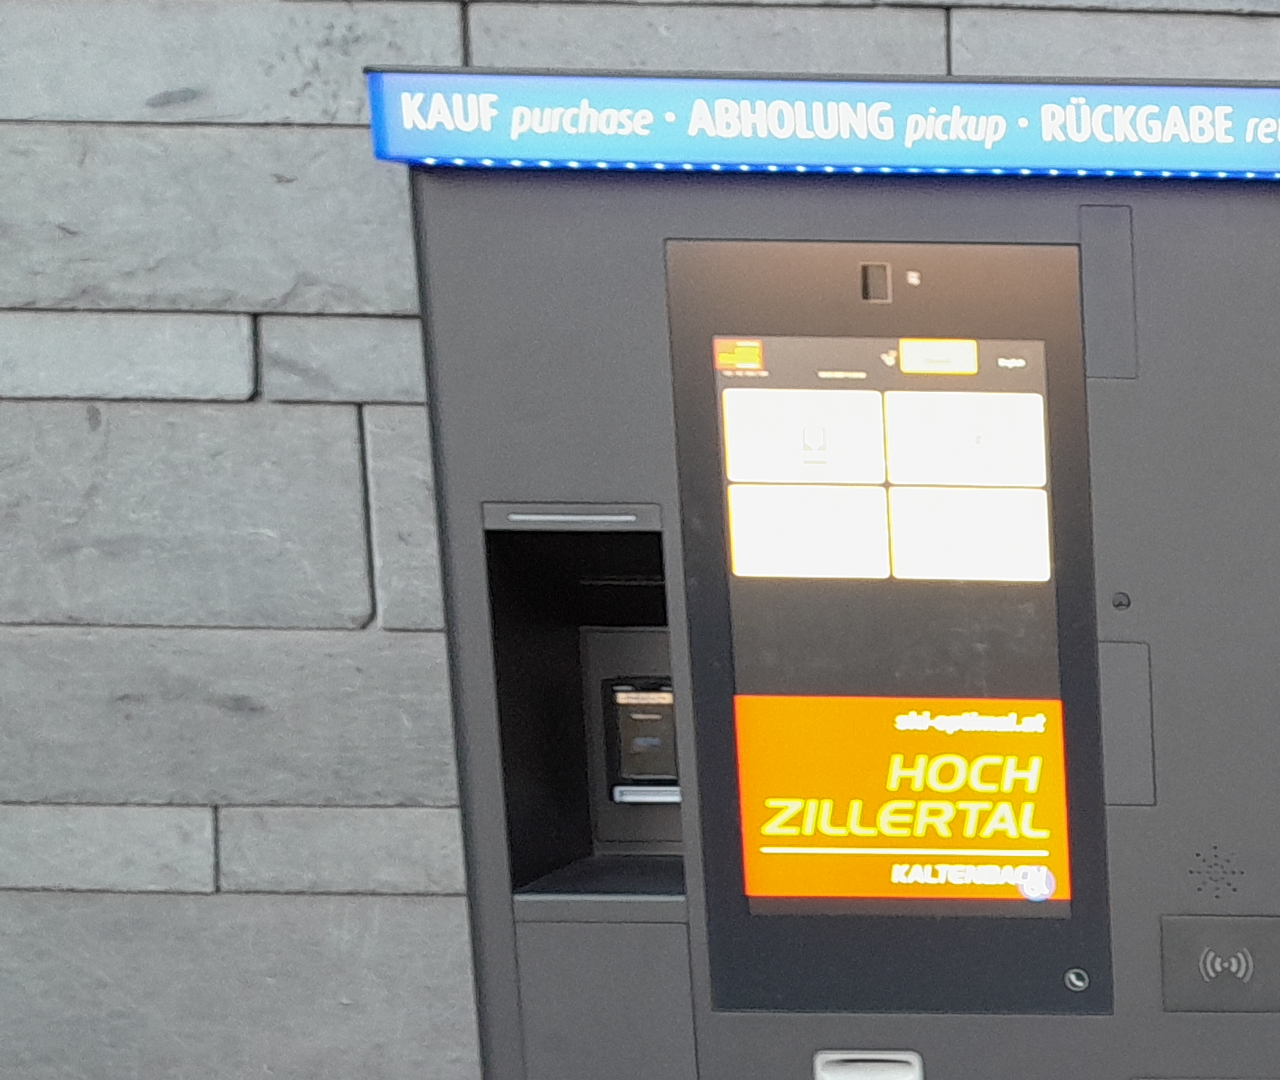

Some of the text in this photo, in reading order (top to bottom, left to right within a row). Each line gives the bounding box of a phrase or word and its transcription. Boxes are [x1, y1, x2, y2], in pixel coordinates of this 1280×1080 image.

[401, 92, 499, 132] KAUF
[511, 99, 654, 140] purchase
[687, 98, 895, 140] ABHOLUNG
[905, 105, 1007, 149] pickup
[1040, 97, 1235, 144] RÜCKGABE
[887, 754, 1043, 793] HOCH
[761, 799, 1050, 839] ZILLERTAL
